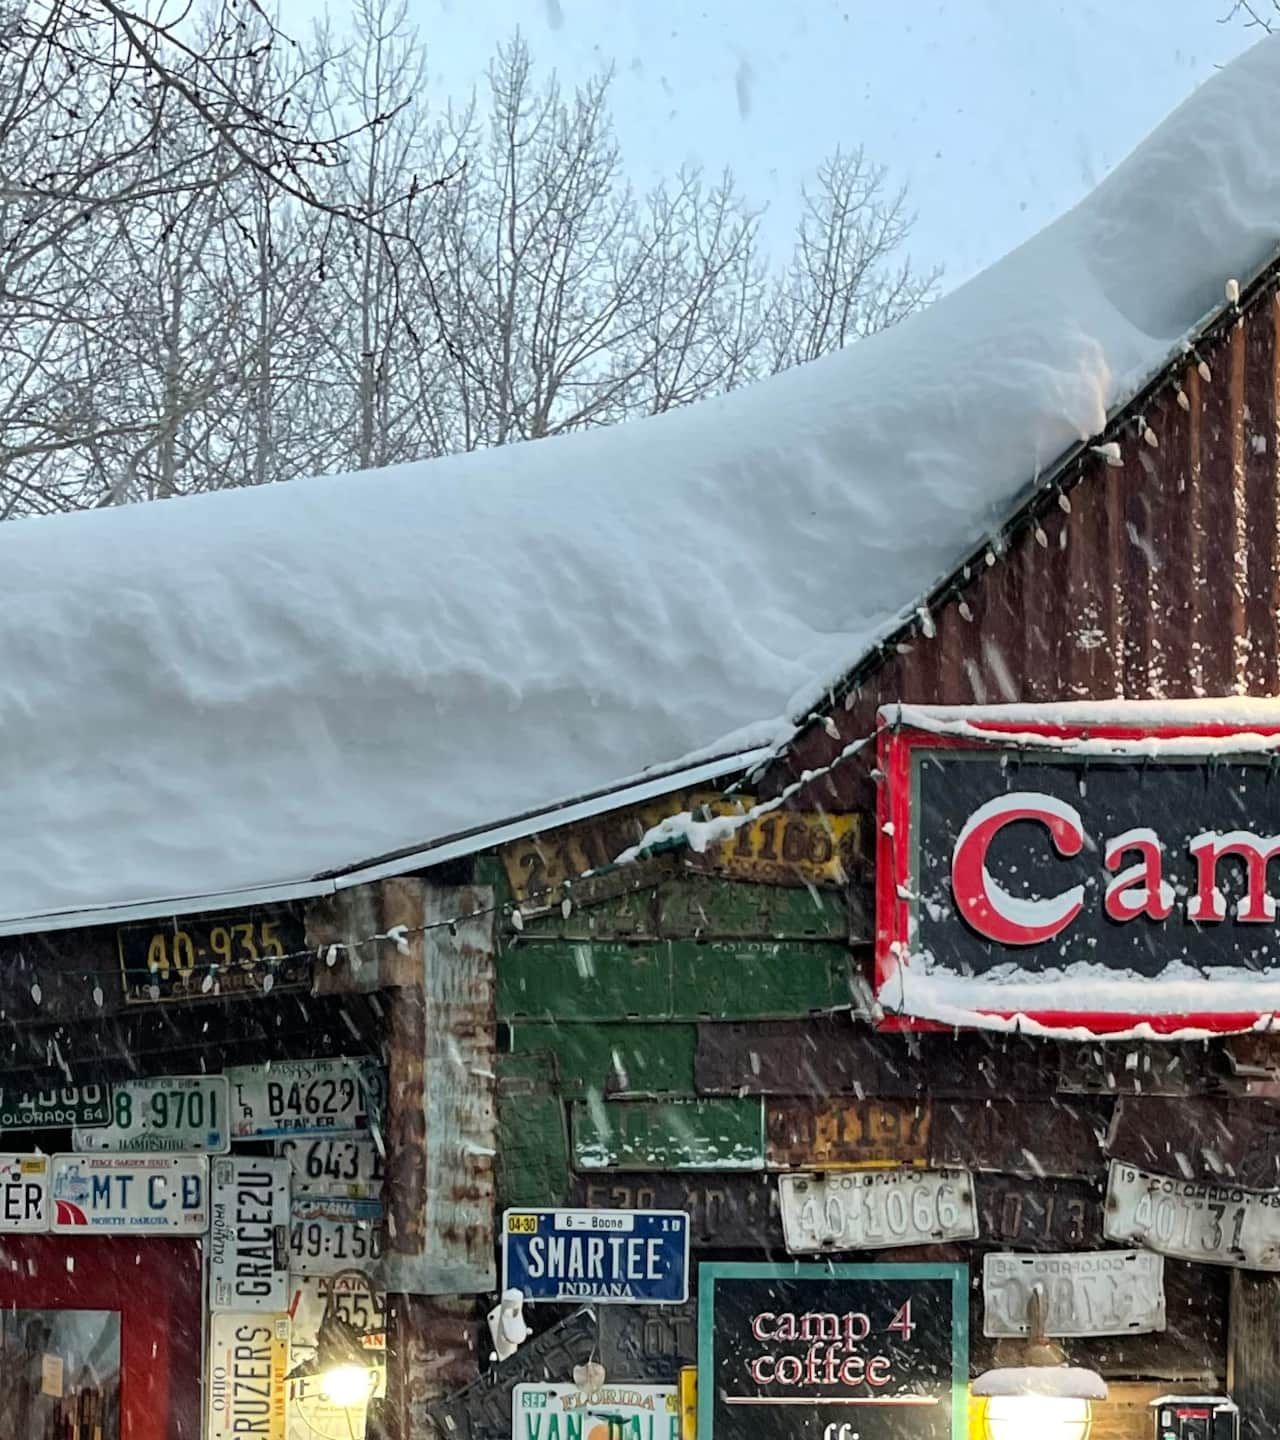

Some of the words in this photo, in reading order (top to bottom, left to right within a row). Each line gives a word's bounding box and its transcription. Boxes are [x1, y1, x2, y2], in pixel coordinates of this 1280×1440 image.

[527, 1235, 664, 1280] SMARTEE
[556, 1282, 634, 1299] INDIANA
[751, 1311, 871, 1353] camp
[884, 1297, 917, 1342] 4
[751, 1341, 892, 1386] coffee
[212, 1367, 227, 1412] OHIO
[560, 1389, 656, 1412] FLORIDA
